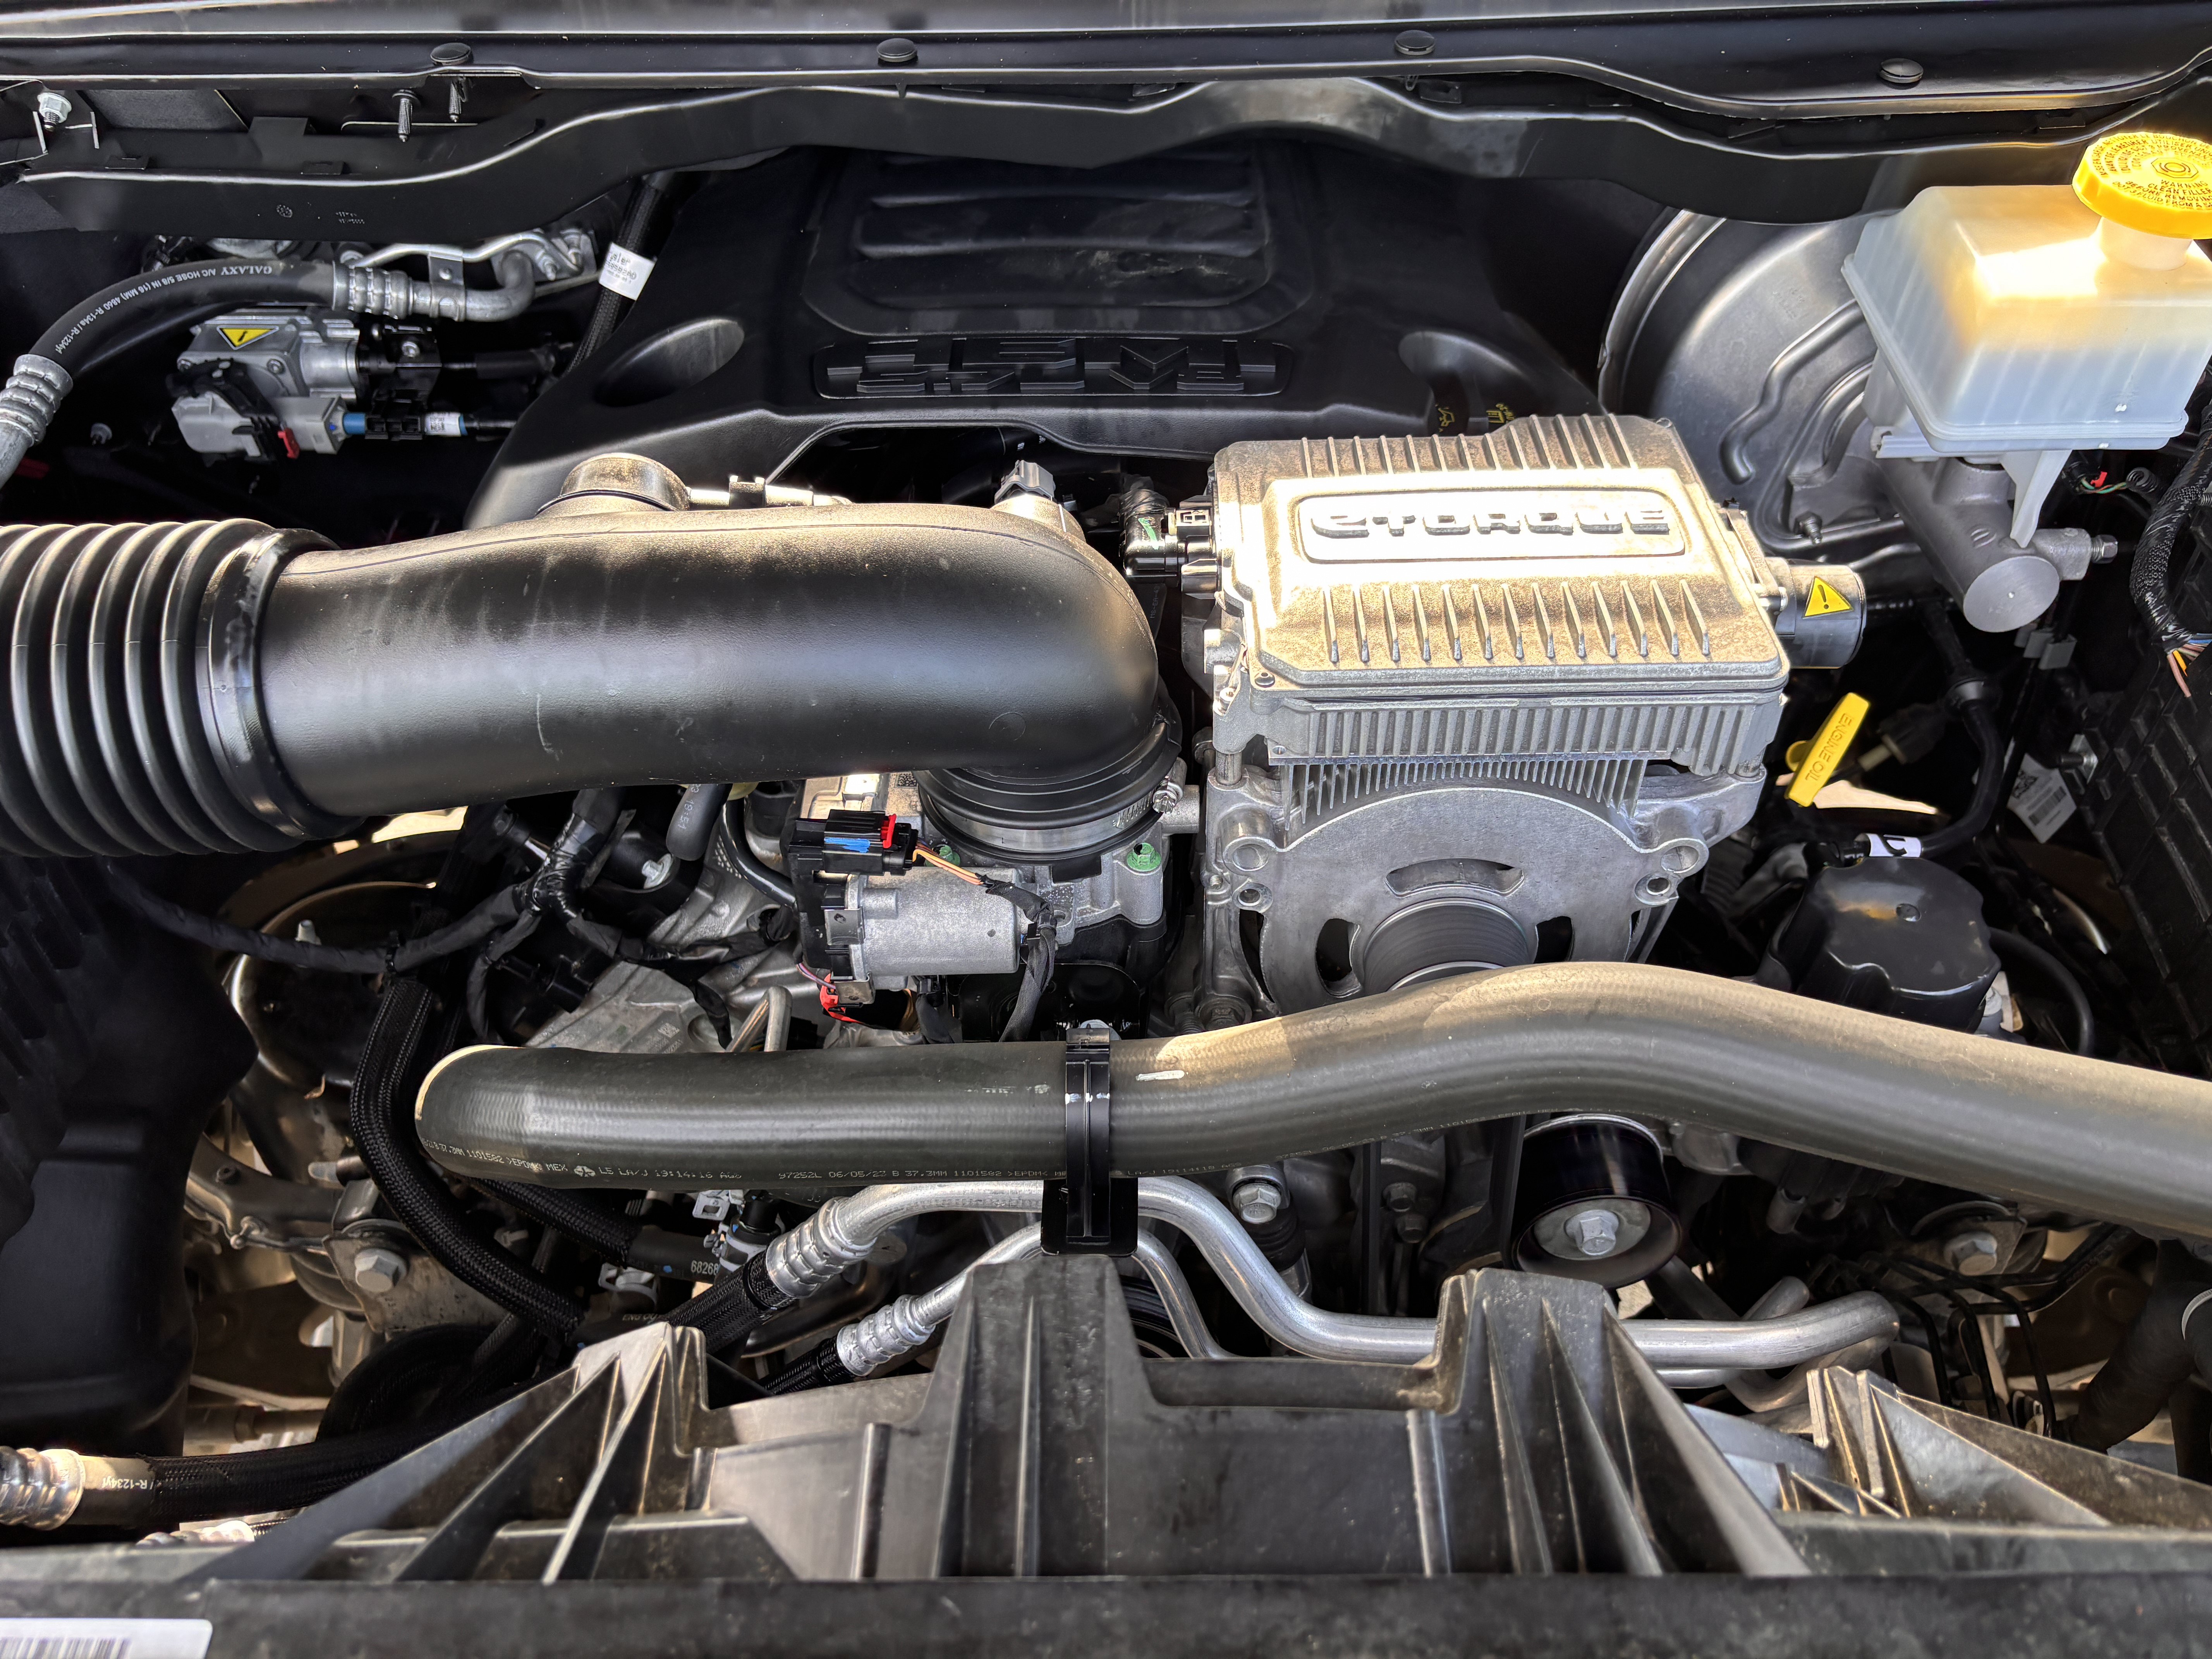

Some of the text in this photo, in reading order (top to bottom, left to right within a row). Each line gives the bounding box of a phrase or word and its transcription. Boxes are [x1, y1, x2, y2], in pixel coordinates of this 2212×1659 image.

[2151, 139, 2192, 149] UTILISER
[2125, 181, 2161, 196] BEFORE
[2148, 183, 2179, 194] CLEAN
[2161, 179, 2208, 188] WARNING
[2112, 181, 2131, 190] DOT
[2136, 192, 2164, 202] FLUID
[175, 270, 200, 282] HOSE
[201, 268, 216, 277] A/C
[221, 265, 272, 276] GALAXY
[151, 279, 161, 289] IN
[161, 275, 175, 286] 5/8
[120, 286, 138, 301] MM)
[137, 282, 151, 293] (16
[103, 296, 121, 311] 4860
[80, 307, 104, 326] R-134a
[55, 326, 79, 355] R-1234yf
[1805, 713, 1853, 782] ENGINE OIL
[690, 1260, 719, 1276] 68268
[102, 1476, 148, 1490] R-1234yf
